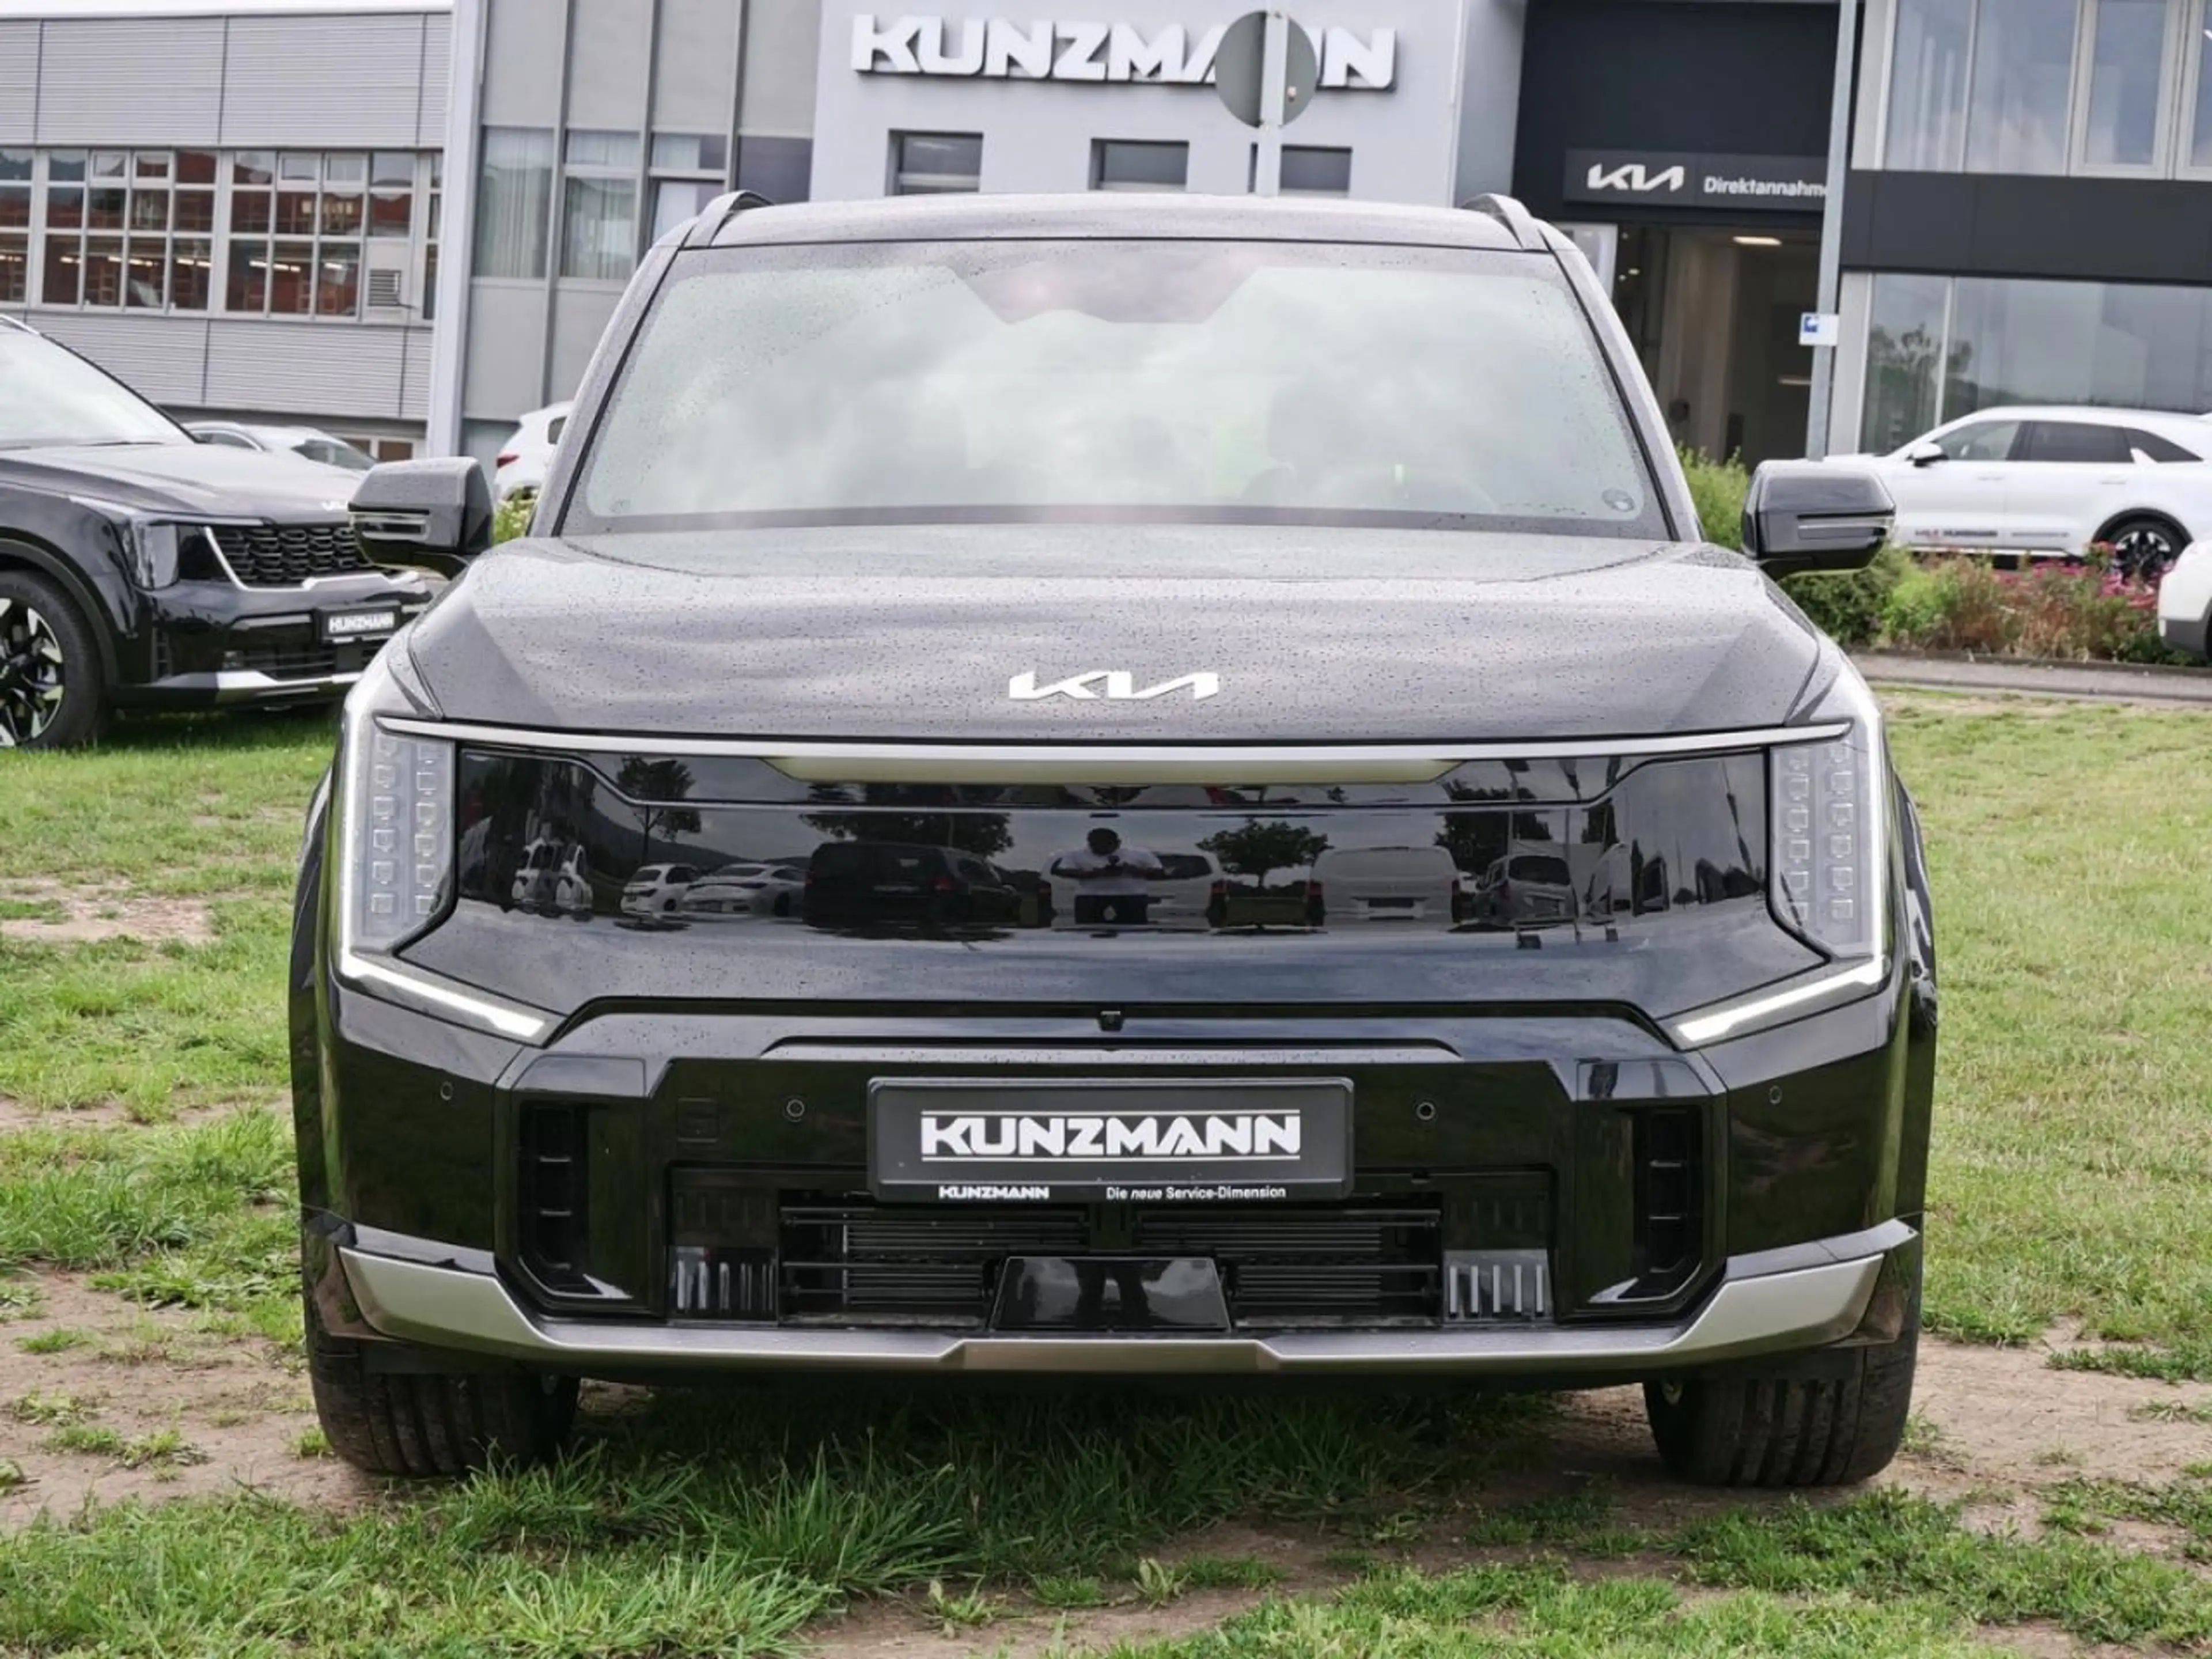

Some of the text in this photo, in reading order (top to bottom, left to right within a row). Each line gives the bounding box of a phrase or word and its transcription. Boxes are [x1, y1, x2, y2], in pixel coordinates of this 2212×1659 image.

[851, 13, 1397, 89] KUNZMN
[1587, 164, 1684, 191] KIA
[1009, 671, 1218, 700] KIA
[922, 1115, 1300, 1156] KUNZMANN
[938, 1185, 1050, 1199] KUNZMANN
[1106, 1185, 1286, 1200] Die neue Service-Dimension
